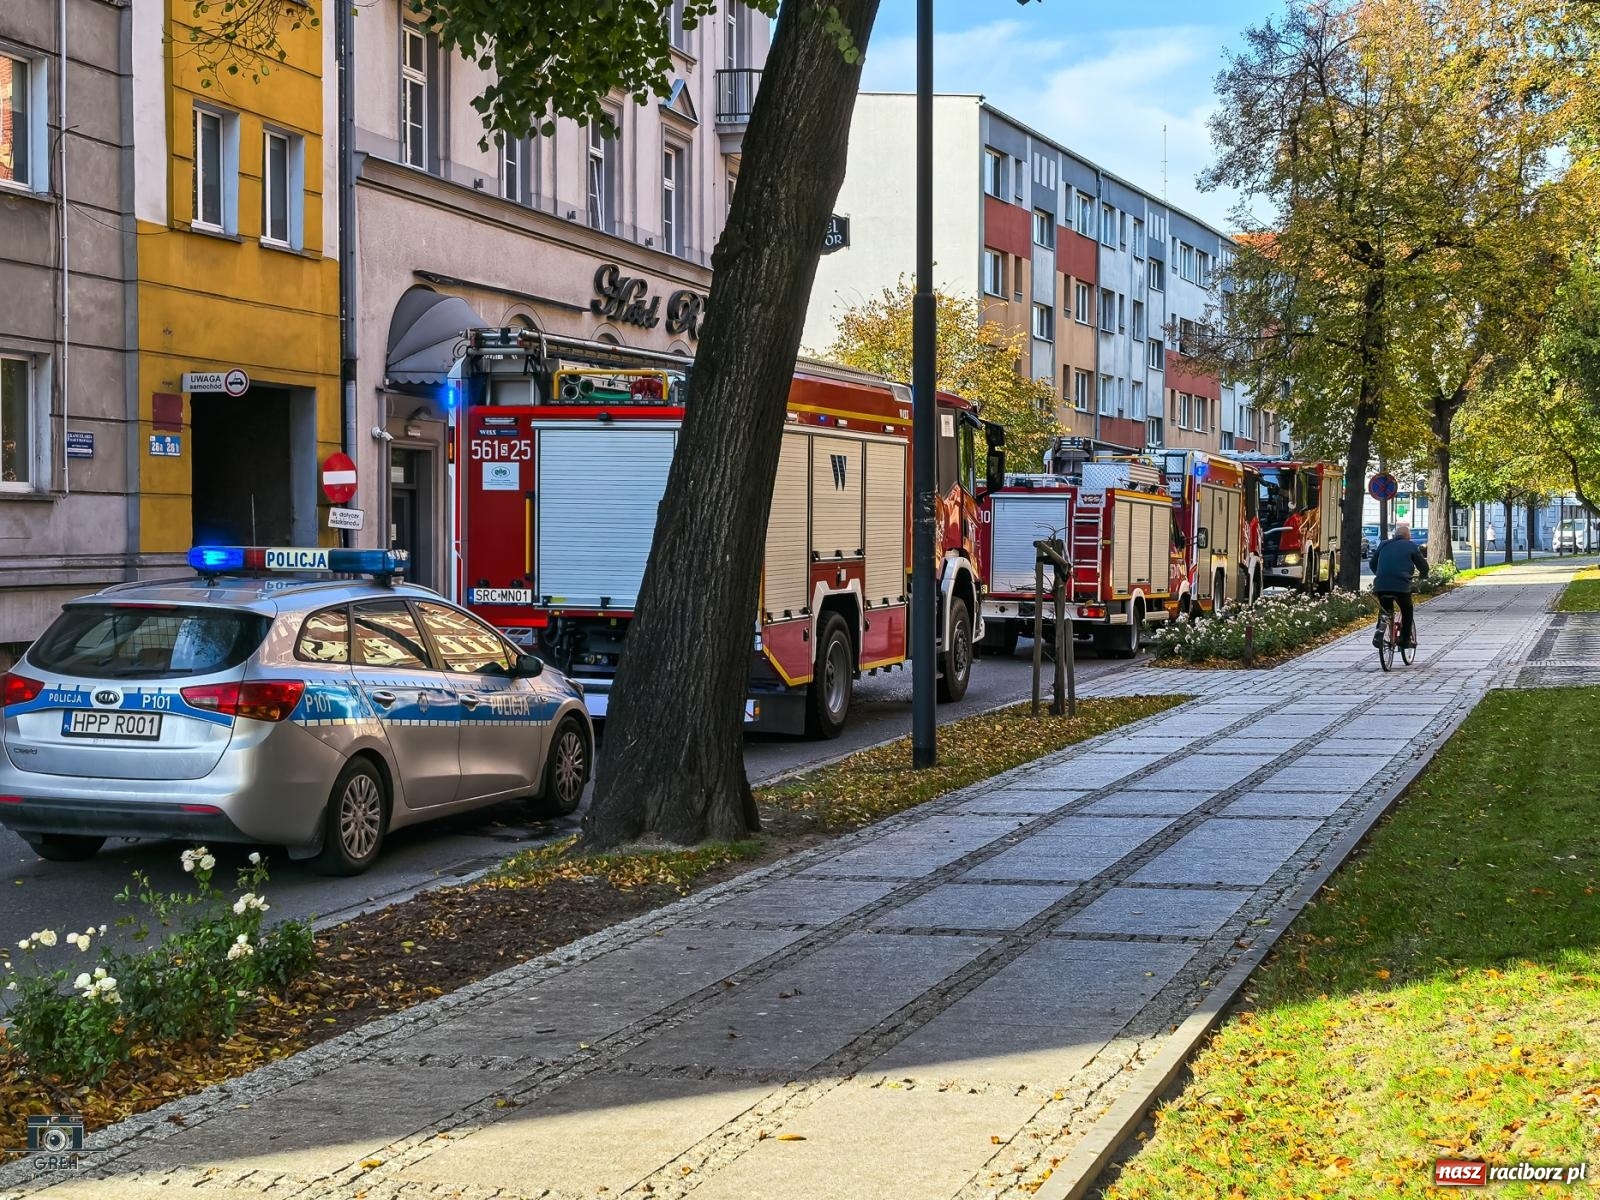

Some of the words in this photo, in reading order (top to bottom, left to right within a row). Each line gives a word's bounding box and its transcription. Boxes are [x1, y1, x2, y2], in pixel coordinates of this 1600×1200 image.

[825, 235, 842, 246] OR
[590, 264, 661, 329] Hotel
[191, 375, 221, 383] UWAGA
[267, 551, 327, 568] POLICJA
[476, 589, 497, 602] SRC
[48, 693, 83, 704] POLICJA
[98, 693, 116, 702] KIA
[142, 694, 171, 710] P101
[305, 693, 333, 714] P101
[491, 694, 531, 716] POLICJA
[73, 713, 110, 733] HPP
[114, 715, 155, 736] R001
